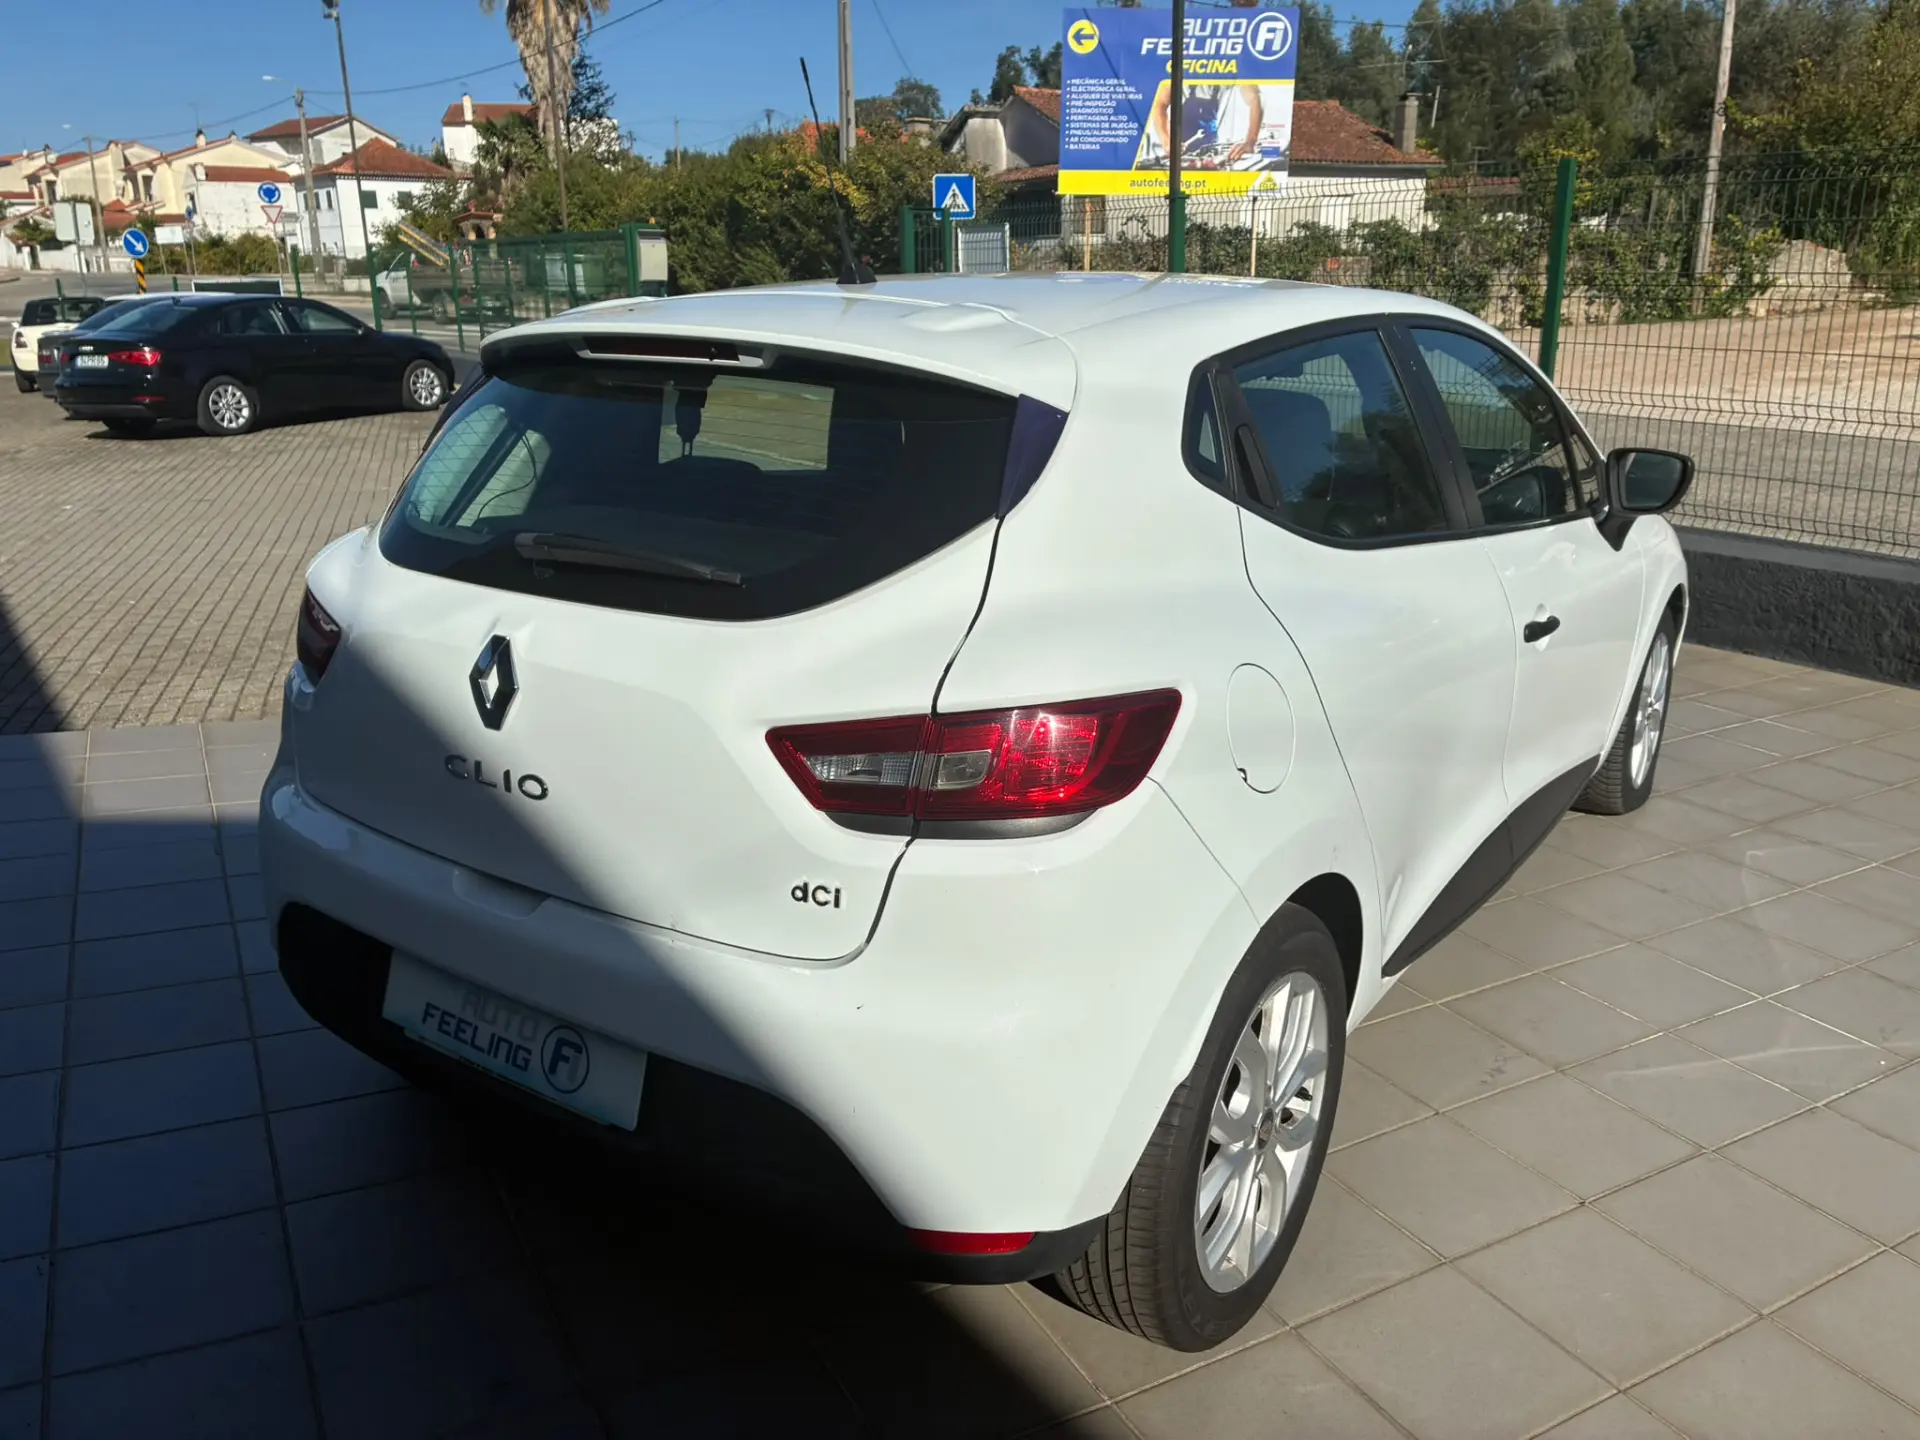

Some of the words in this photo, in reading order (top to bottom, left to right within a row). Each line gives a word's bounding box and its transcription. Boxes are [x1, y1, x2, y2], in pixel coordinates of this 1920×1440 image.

[1071, 77, 1104, 85] MECÂNICA
[1130, 178, 1207, 189] autofeeng.pt
[444, 754, 549, 801] CLIO
[421, 1001, 533, 1073] FEELING
[460, 990, 541, 1042] AUTO
